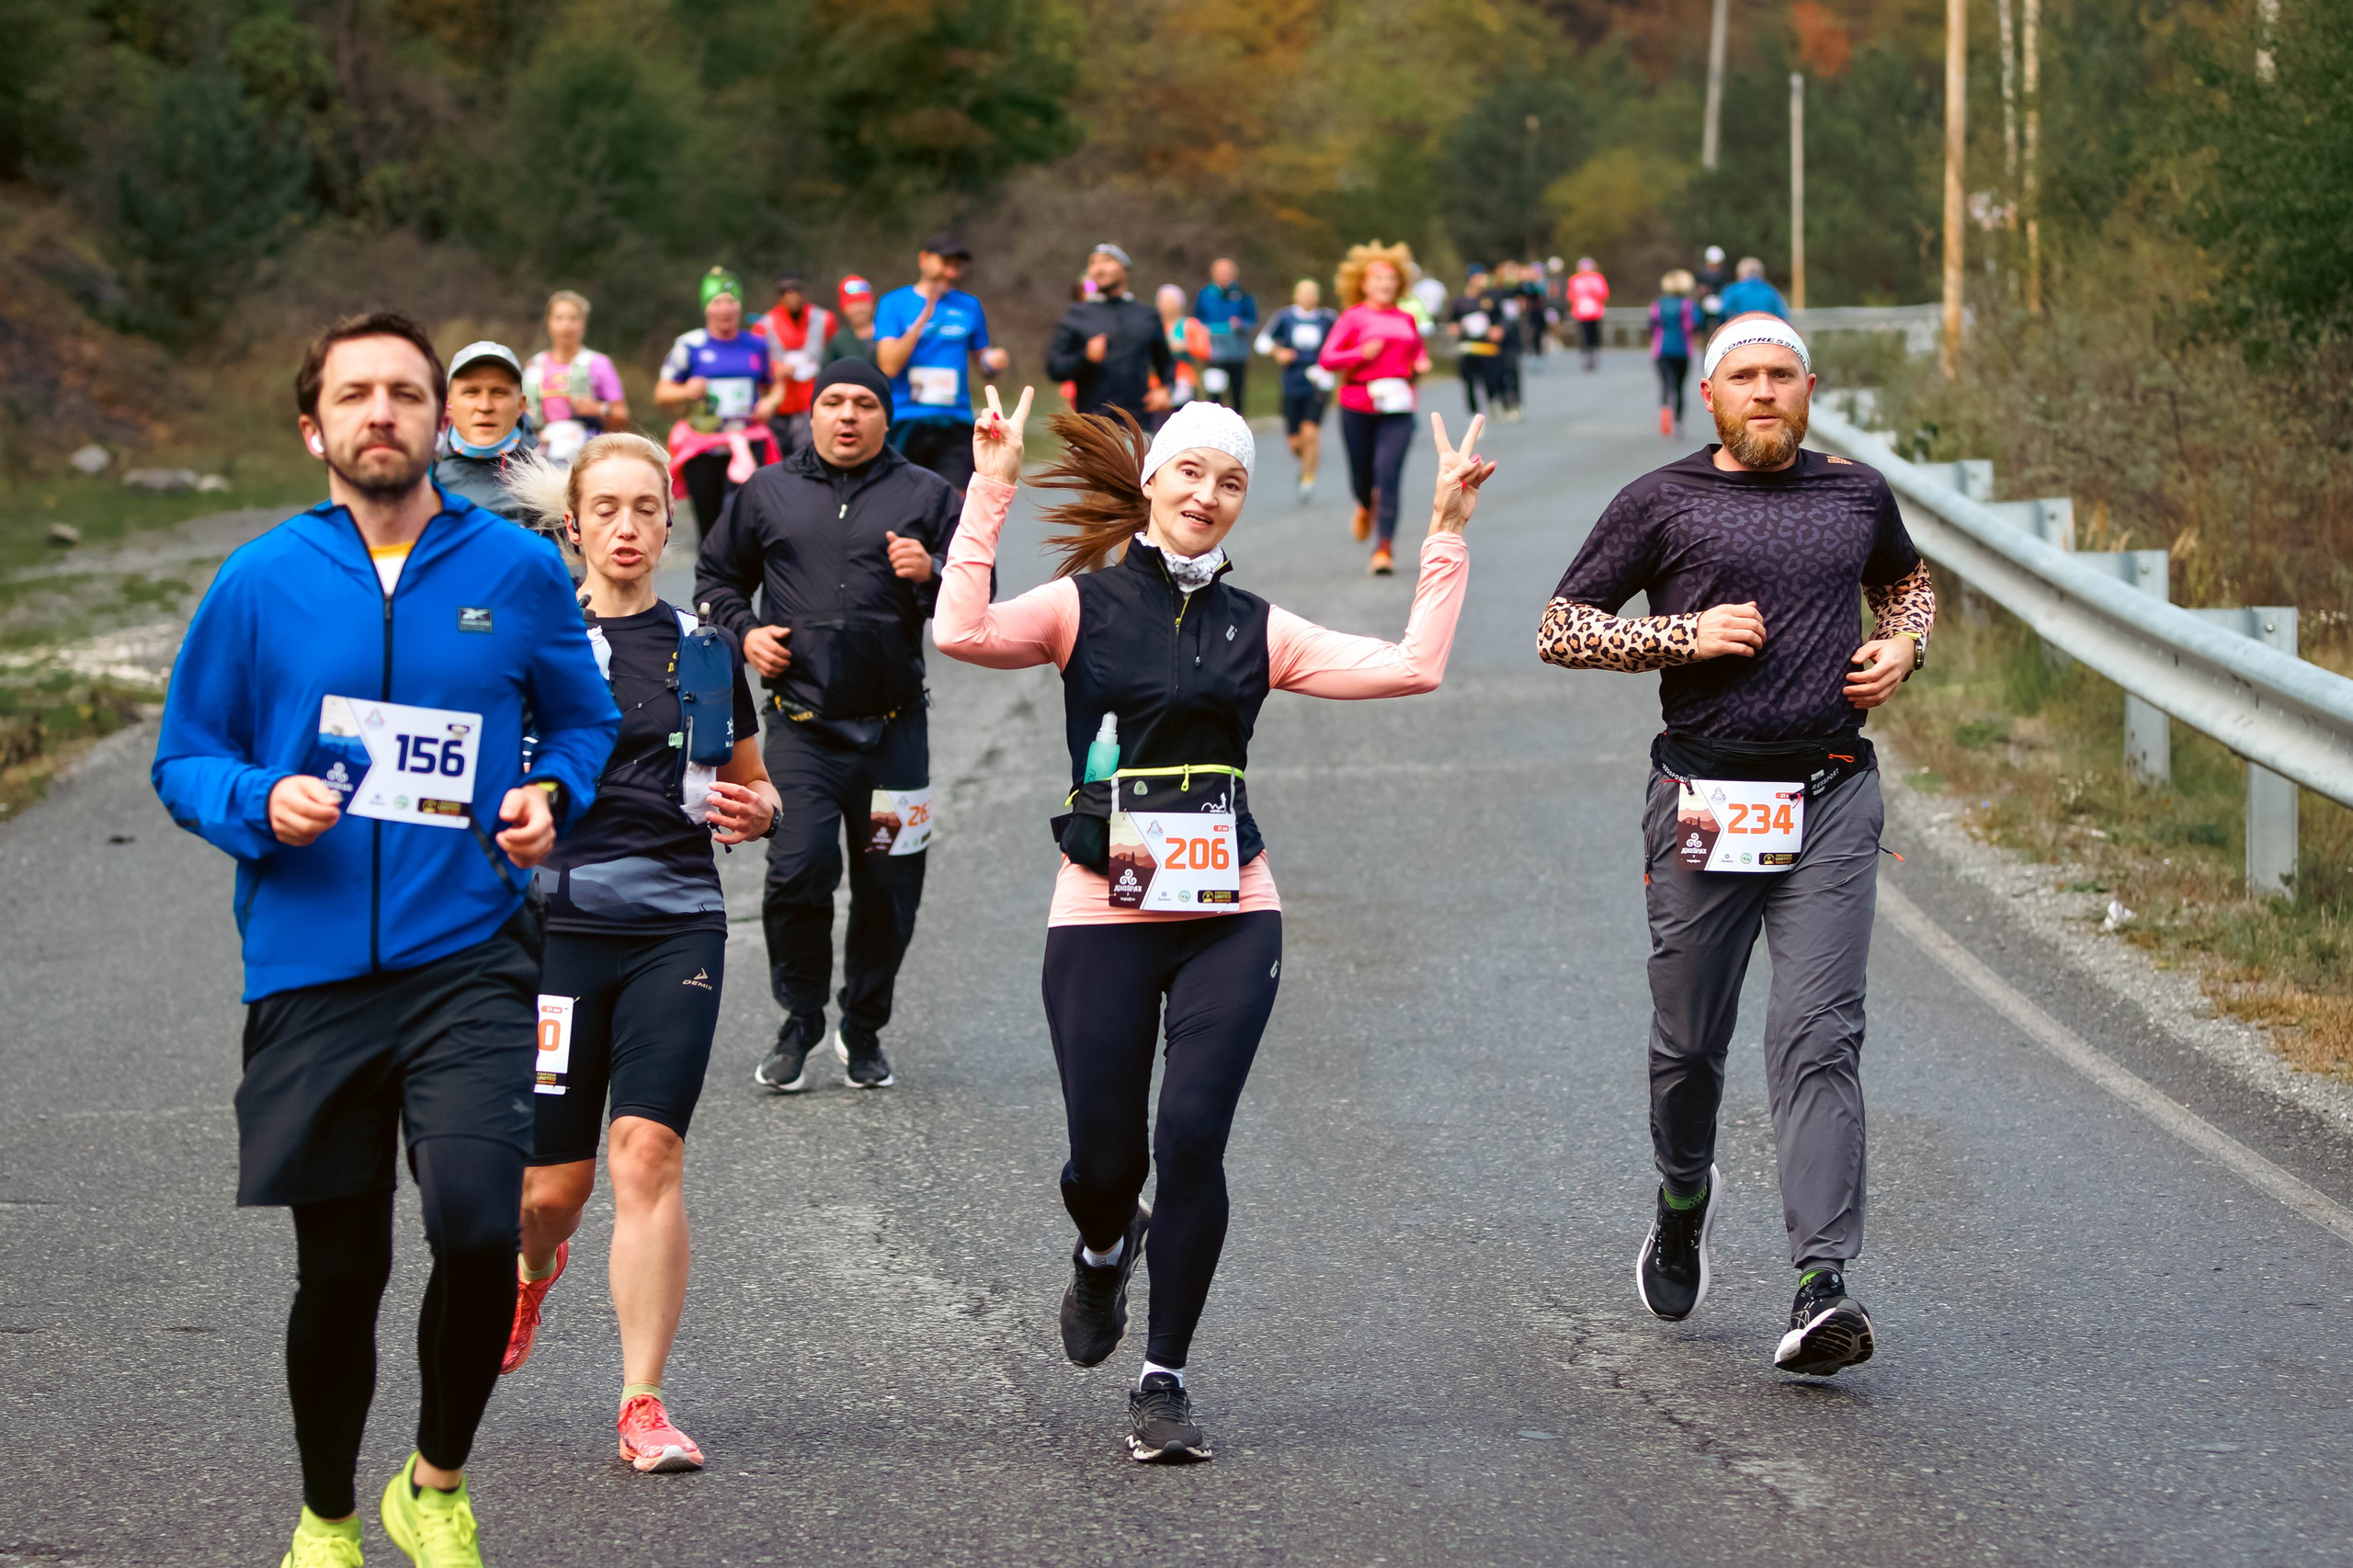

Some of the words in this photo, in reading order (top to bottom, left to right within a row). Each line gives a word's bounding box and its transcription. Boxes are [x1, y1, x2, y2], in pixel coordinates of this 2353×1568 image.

[1722, 336, 1806, 365] COMPRESSPORT
[396, 733, 465, 778] 156
[1727, 803, 1794, 835] 234
[1165, 837, 1229, 869] 206
[682, 979, 713, 991] DEMIX
